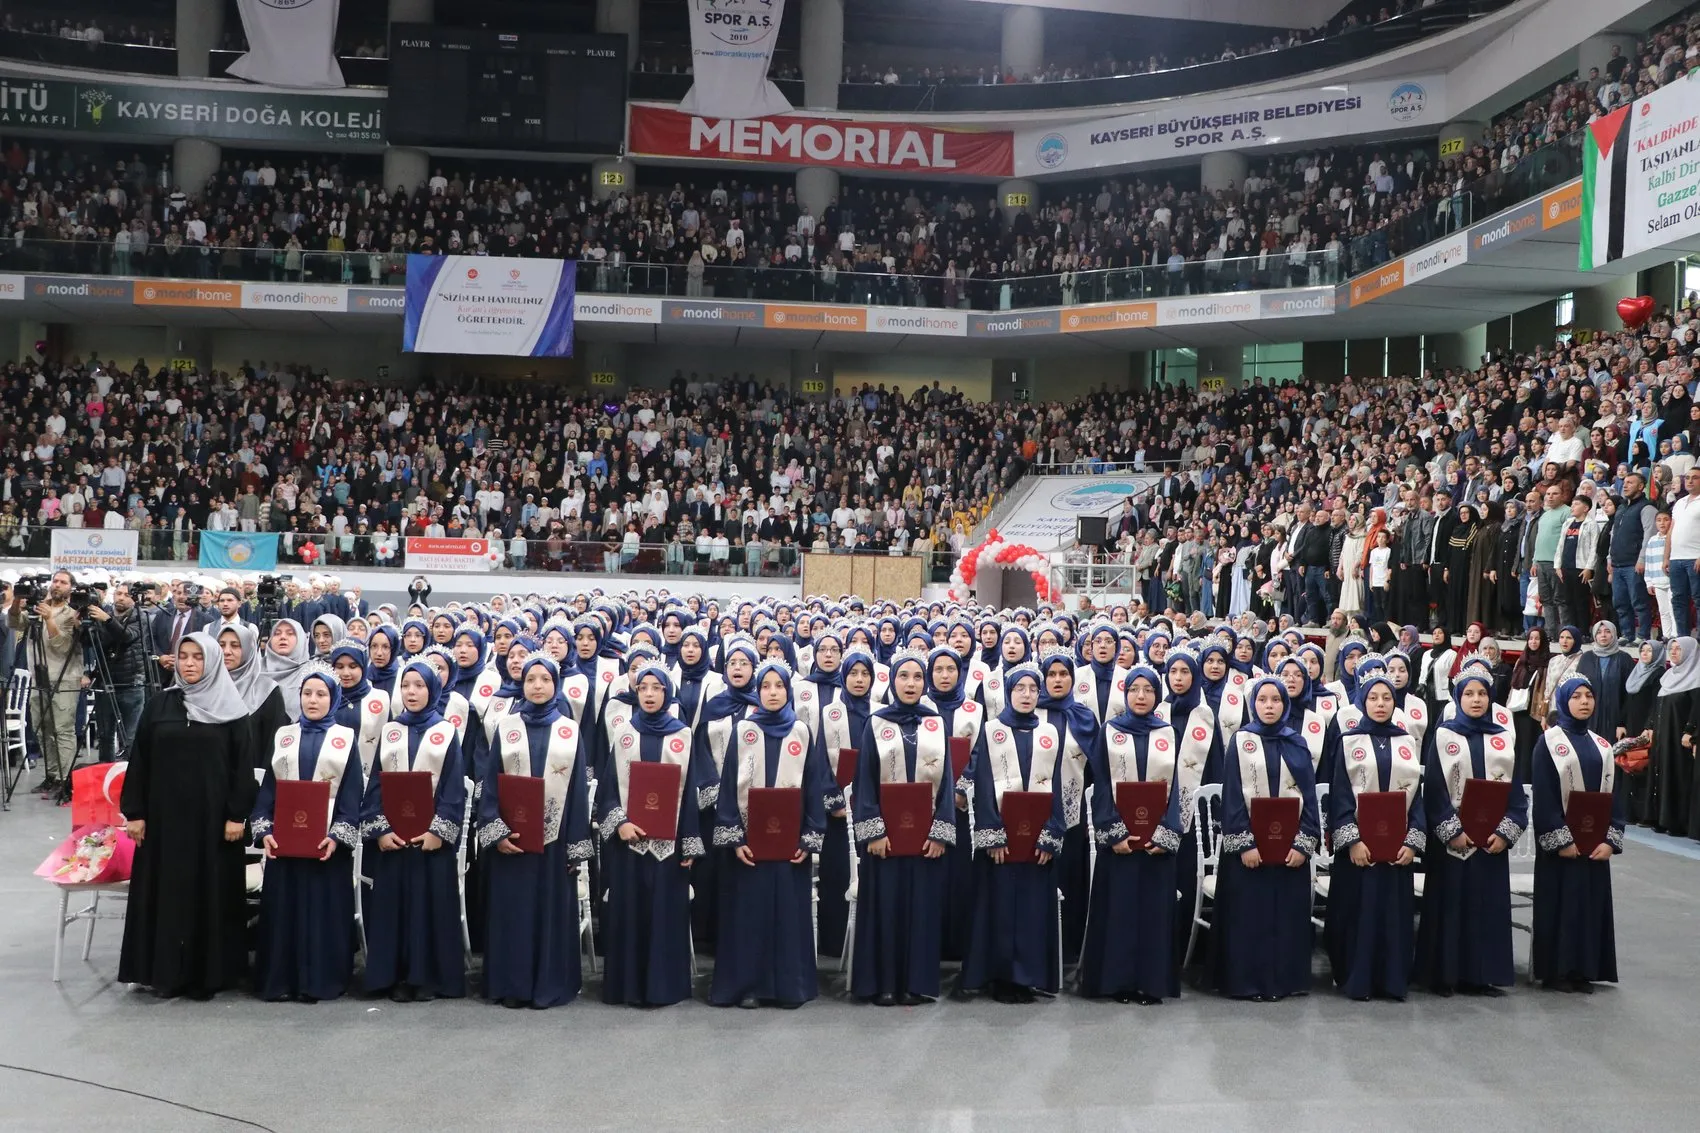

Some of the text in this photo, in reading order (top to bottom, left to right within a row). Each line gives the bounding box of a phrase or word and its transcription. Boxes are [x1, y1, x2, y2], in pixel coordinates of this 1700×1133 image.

[704, 12, 773, 29] SPOR A.Ş.
[401, 39, 430, 48] PLAYER
[729, 33, 748, 41] 2010
[586, 48, 616, 58] PLAYER
[1, 81, 48, 111] İTÜ
[117, 101, 381, 129] KAYSERİ DOĞA KOLEJİ
[1390, 106, 1408, 114] SPOR
[20, 113, 66, 125] VAKFI
[1090, 96, 1362, 145] KAYSERİ BÜYÜKŞEHİR BELEDİYESİ
[690, 116, 956, 168] MEMORIAL
[1174, 126, 1266, 148] SPOR A.Ş.
[1441, 140, 1461, 153] 217
[1658, 180, 1700, 207] Gazze'
[1647, 211, 1681, 234] Selam
[1481, 213, 1537, 246] mondihome
[1416, 243, 1463, 273] mondihome
[47, 284, 125, 297] mondihome
[155, 287, 232, 301] mondihome
[263, 291, 338, 305] mondihome
[472, 295, 485, 303] EN
[579, 304, 653, 316] mondihome
[682, 307, 756, 320] mondihome
[1178, 303, 1251, 317] mondihome
[786, 313, 858, 325] mondihome
[887, 316, 958, 329] mondihome
[987, 318, 1052, 331] mondihome
[1080, 311, 1148, 325] mondihome
[173, 360, 191, 369] 121
[594, 374, 613, 384] 120
[805, 382, 824, 391] 119
[54, 556, 99, 565] HAFIZLIK
